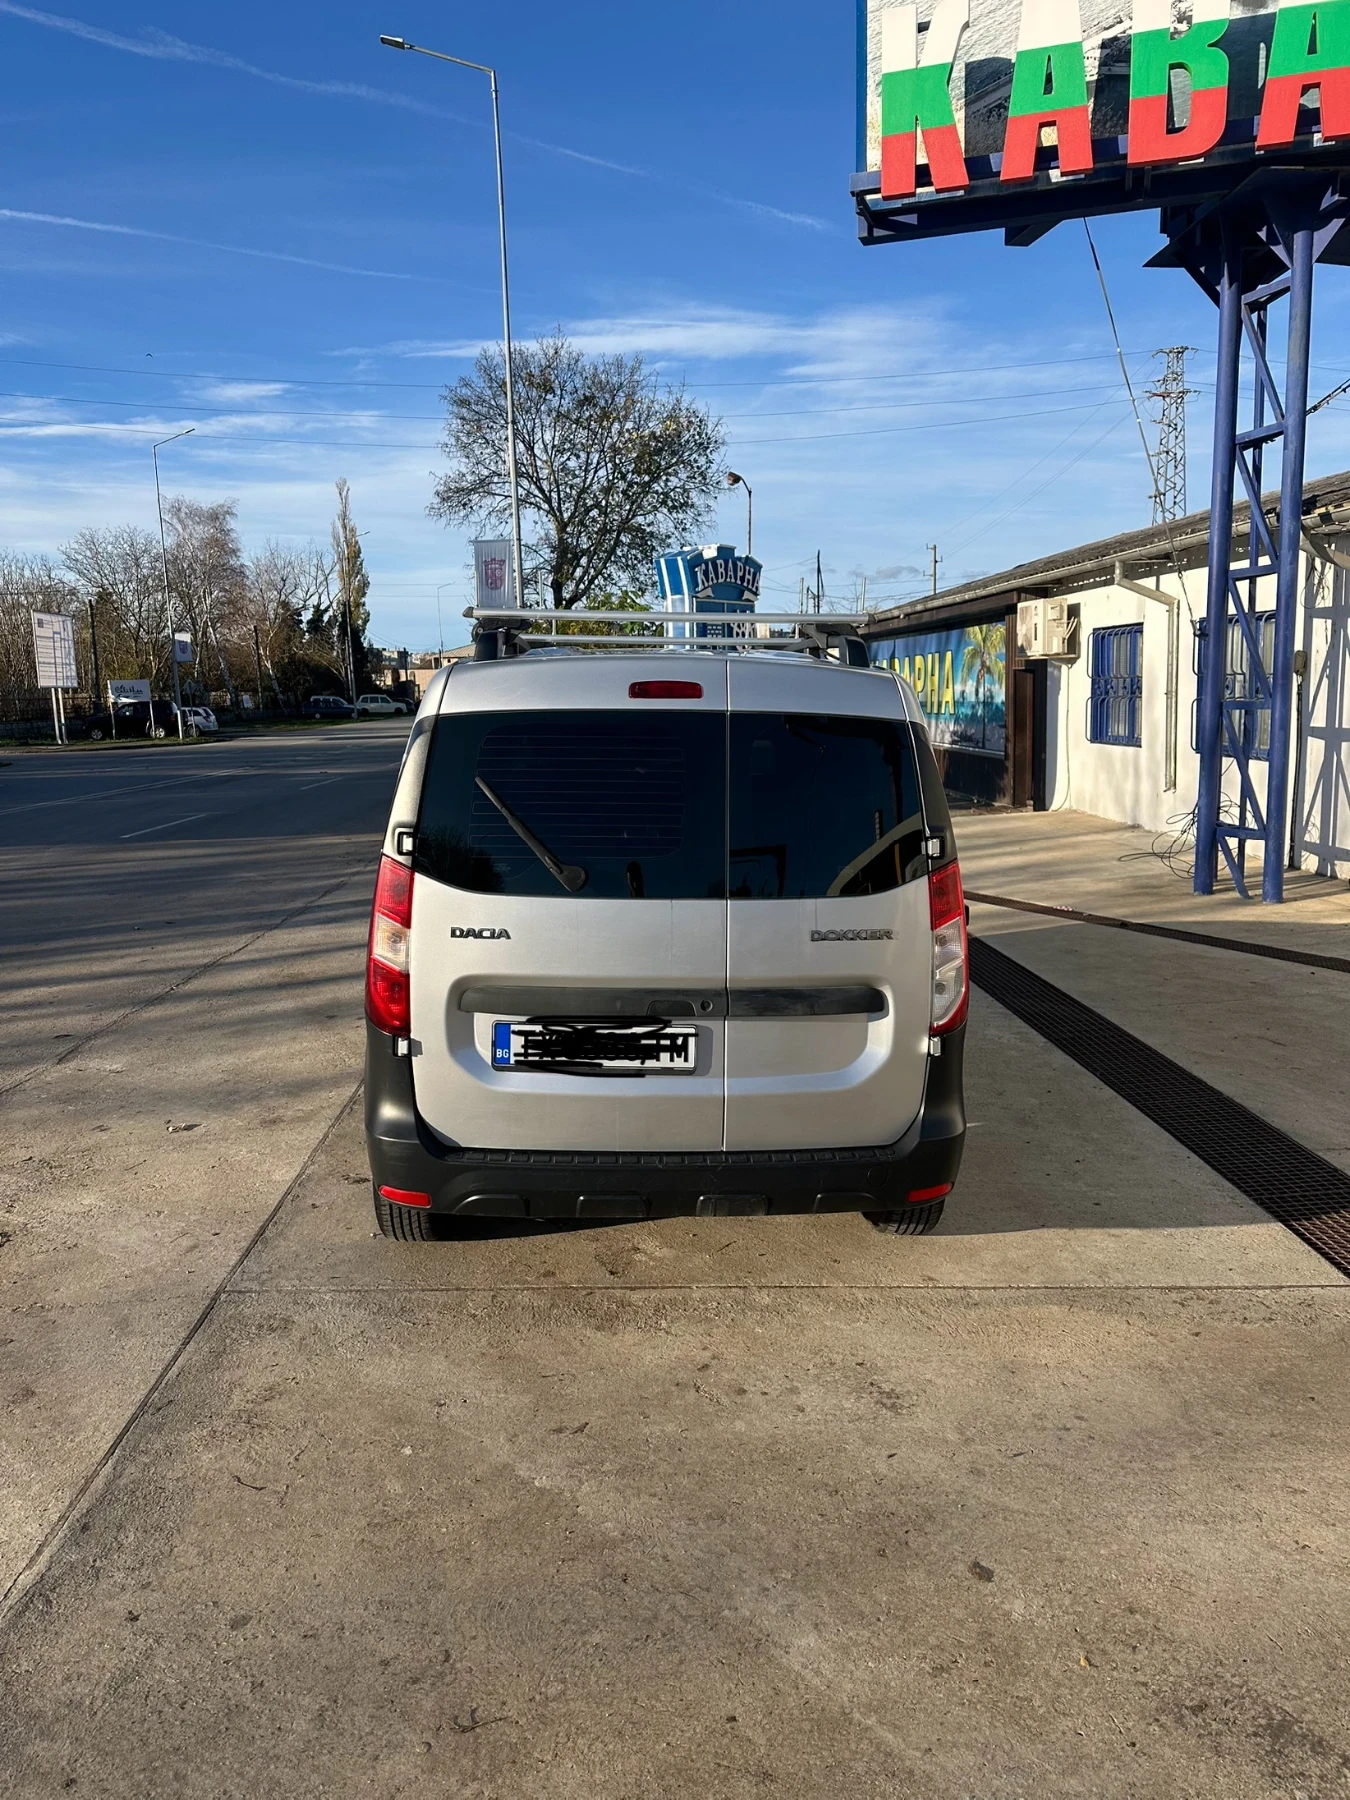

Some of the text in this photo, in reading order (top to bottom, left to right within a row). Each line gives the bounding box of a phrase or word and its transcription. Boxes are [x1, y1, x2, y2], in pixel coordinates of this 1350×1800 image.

[695, 559, 761, 595] КАВАРНА
[450, 926, 512, 940] DACIA
[810, 928, 894, 942] DOKKER
[496, 1049, 510, 1059] BG
